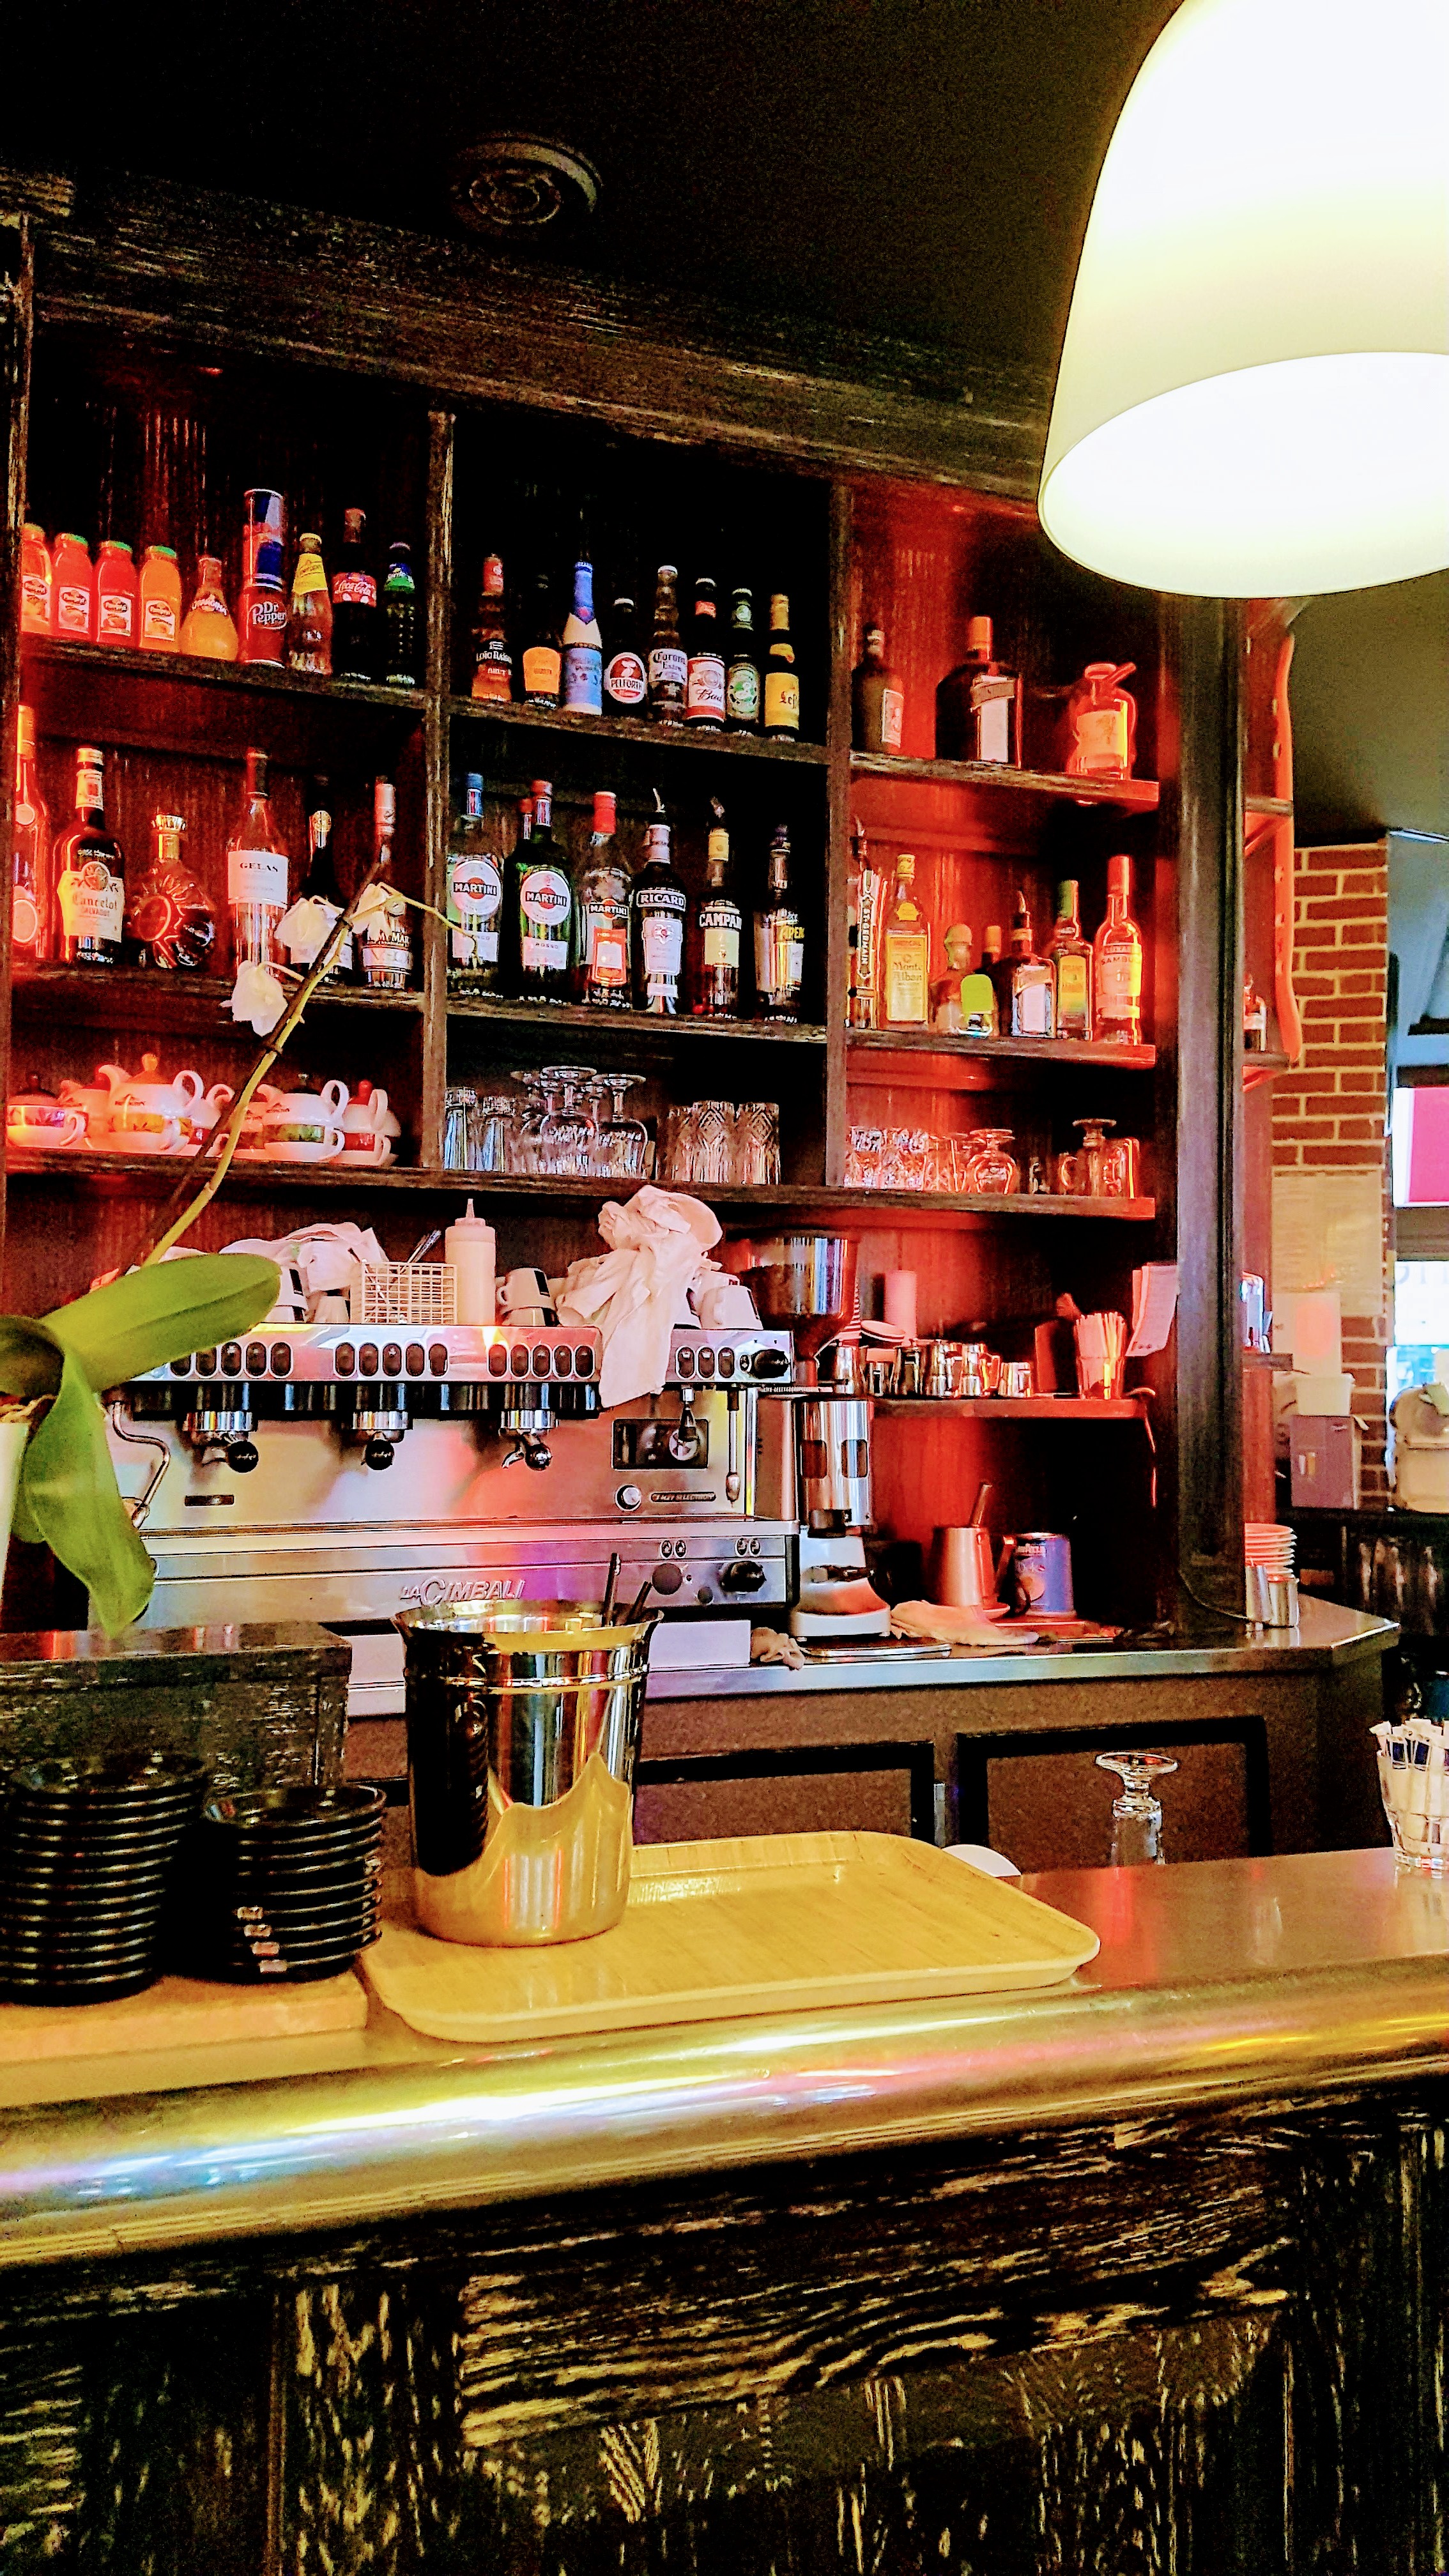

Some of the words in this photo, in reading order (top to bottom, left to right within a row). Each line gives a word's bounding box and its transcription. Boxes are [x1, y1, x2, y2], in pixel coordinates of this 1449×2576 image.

[263, 601, 279, 613] Dr
[251, 603, 287, 625] Pepper
[653, 652, 686, 664] Corona
[696, 689, 723, 702] Bud
[454, 882, 497, 895] MARTINI
[526, 892, 567, 906] MARTINI
[640, 894, 684, 907] RICARD
[590, 905, 627, 916] MARTINI
[700, 913, 742, 930] CAMPAR
[400, 1586, 421, 1600] LA
[420, 1576, 526, 1606] CIMBALI
